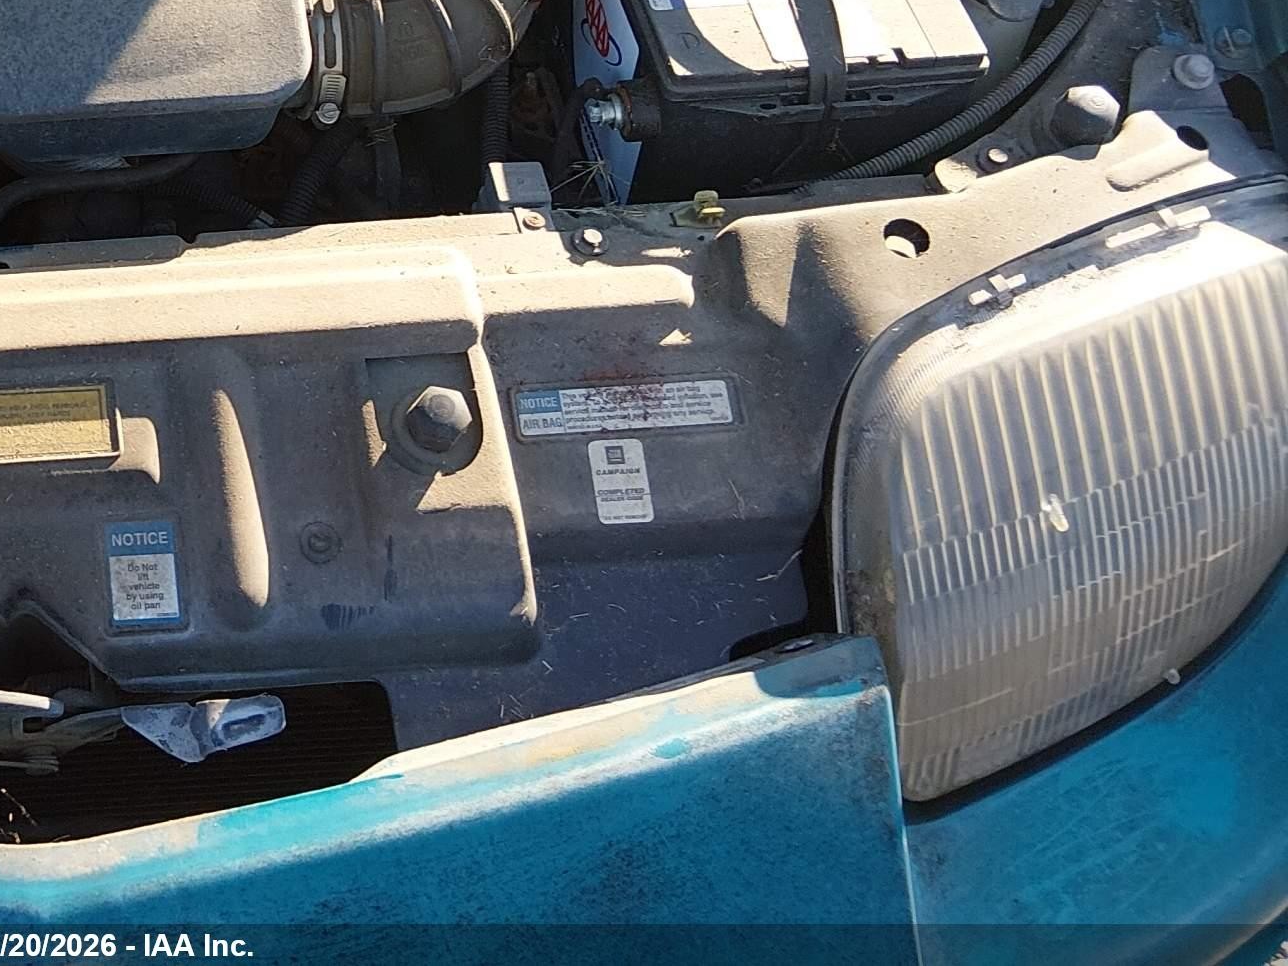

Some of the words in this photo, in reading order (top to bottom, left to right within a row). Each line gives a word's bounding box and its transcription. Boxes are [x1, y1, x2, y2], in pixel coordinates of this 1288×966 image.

[520, 397, 558, 409] NOTICE
[522, 418, 540, 429] AIR
[543, 417, 562, 429] BAG
[596, 467, 640, 475] CAMPAIGN
[597, 488, 645, 496] COMPLETED
[112, 531, 169, 547] NOTICE
[127, 564, 140, 572] Do
[142, 563, 159, 572] Not
[129, 582, 160, 591] vehicle
[126, 594, 138, 602] by
[139, 592, 164, 601] using
[130, 602, 142, 610] oil
[144, 602, 161, 611] pan
